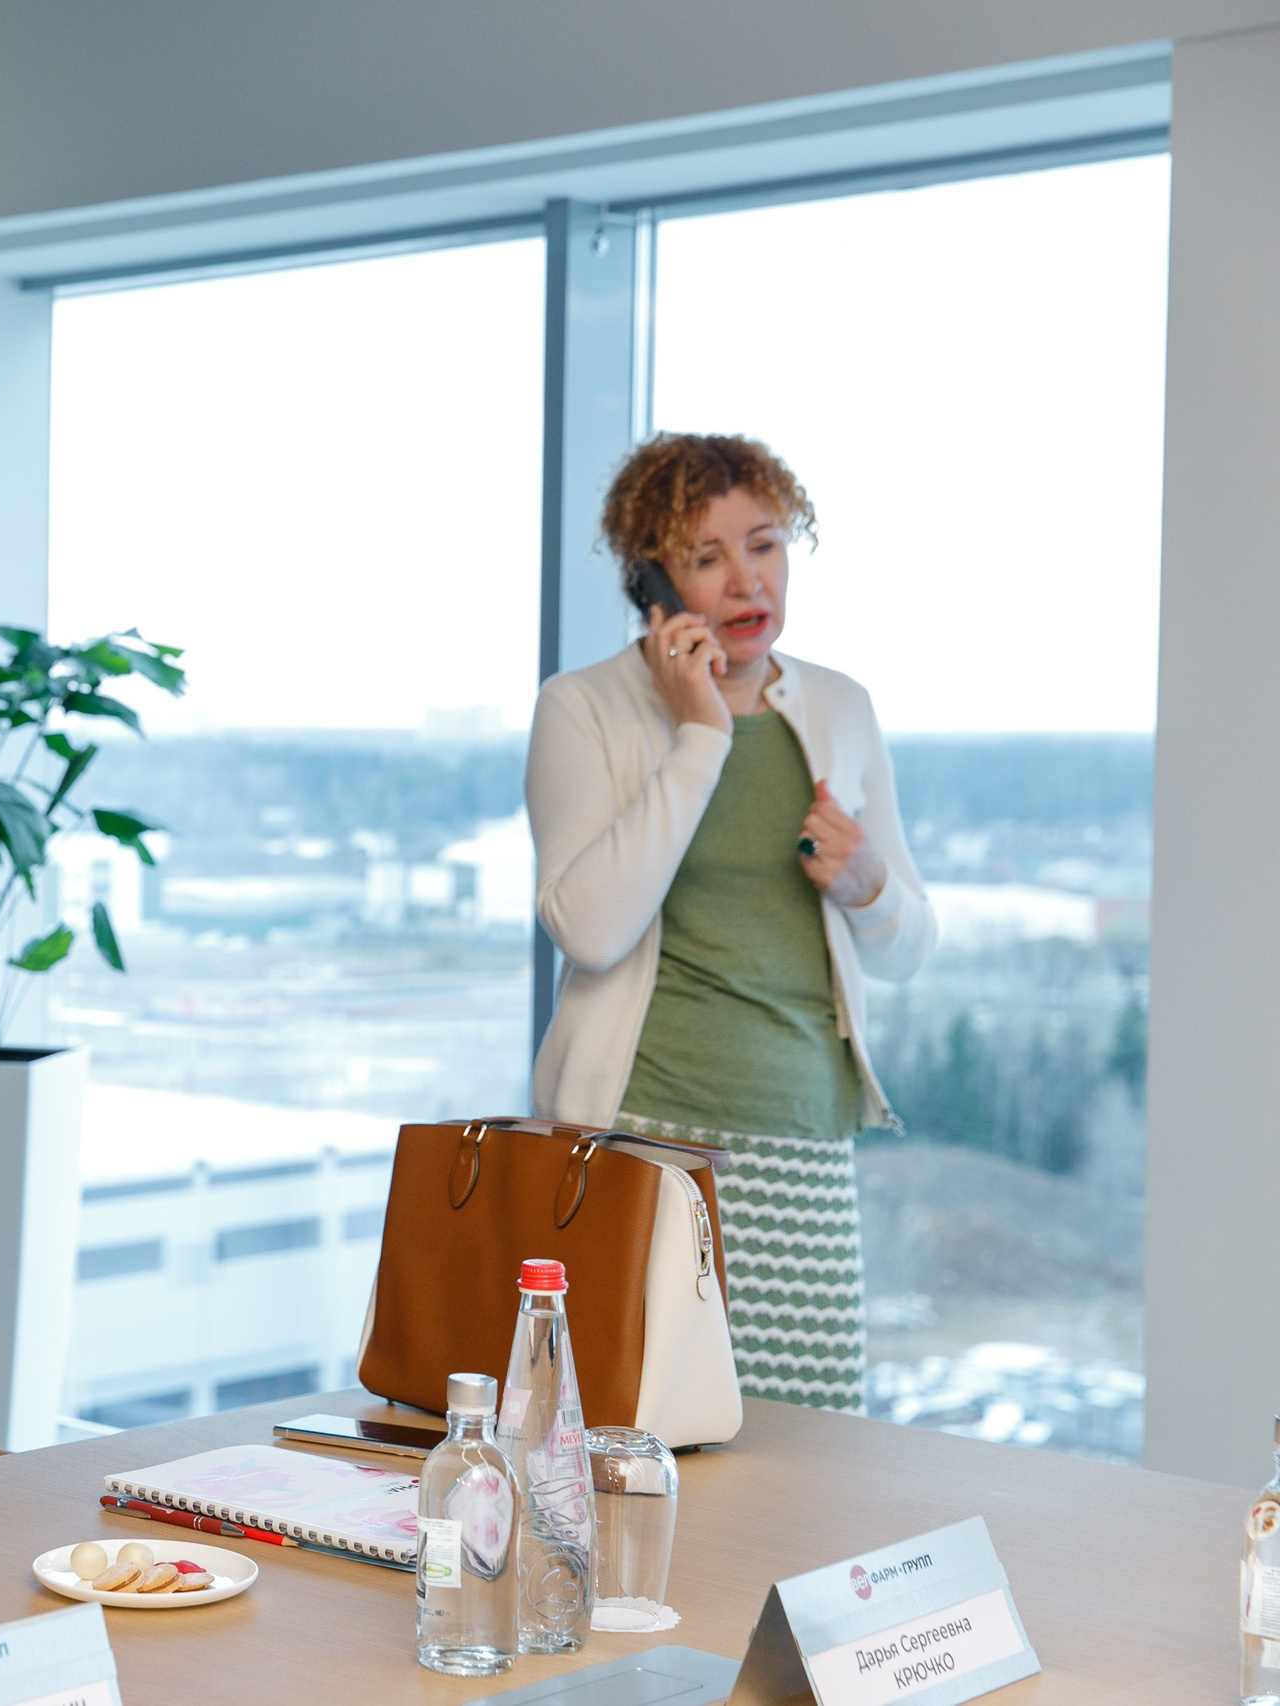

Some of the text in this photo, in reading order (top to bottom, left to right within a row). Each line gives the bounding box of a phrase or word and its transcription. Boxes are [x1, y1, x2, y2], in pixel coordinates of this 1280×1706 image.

[855, 1617, 973, 1674] Дарья Сергеевна
[892, 1652, 955, 1690] КРЮЧКО
